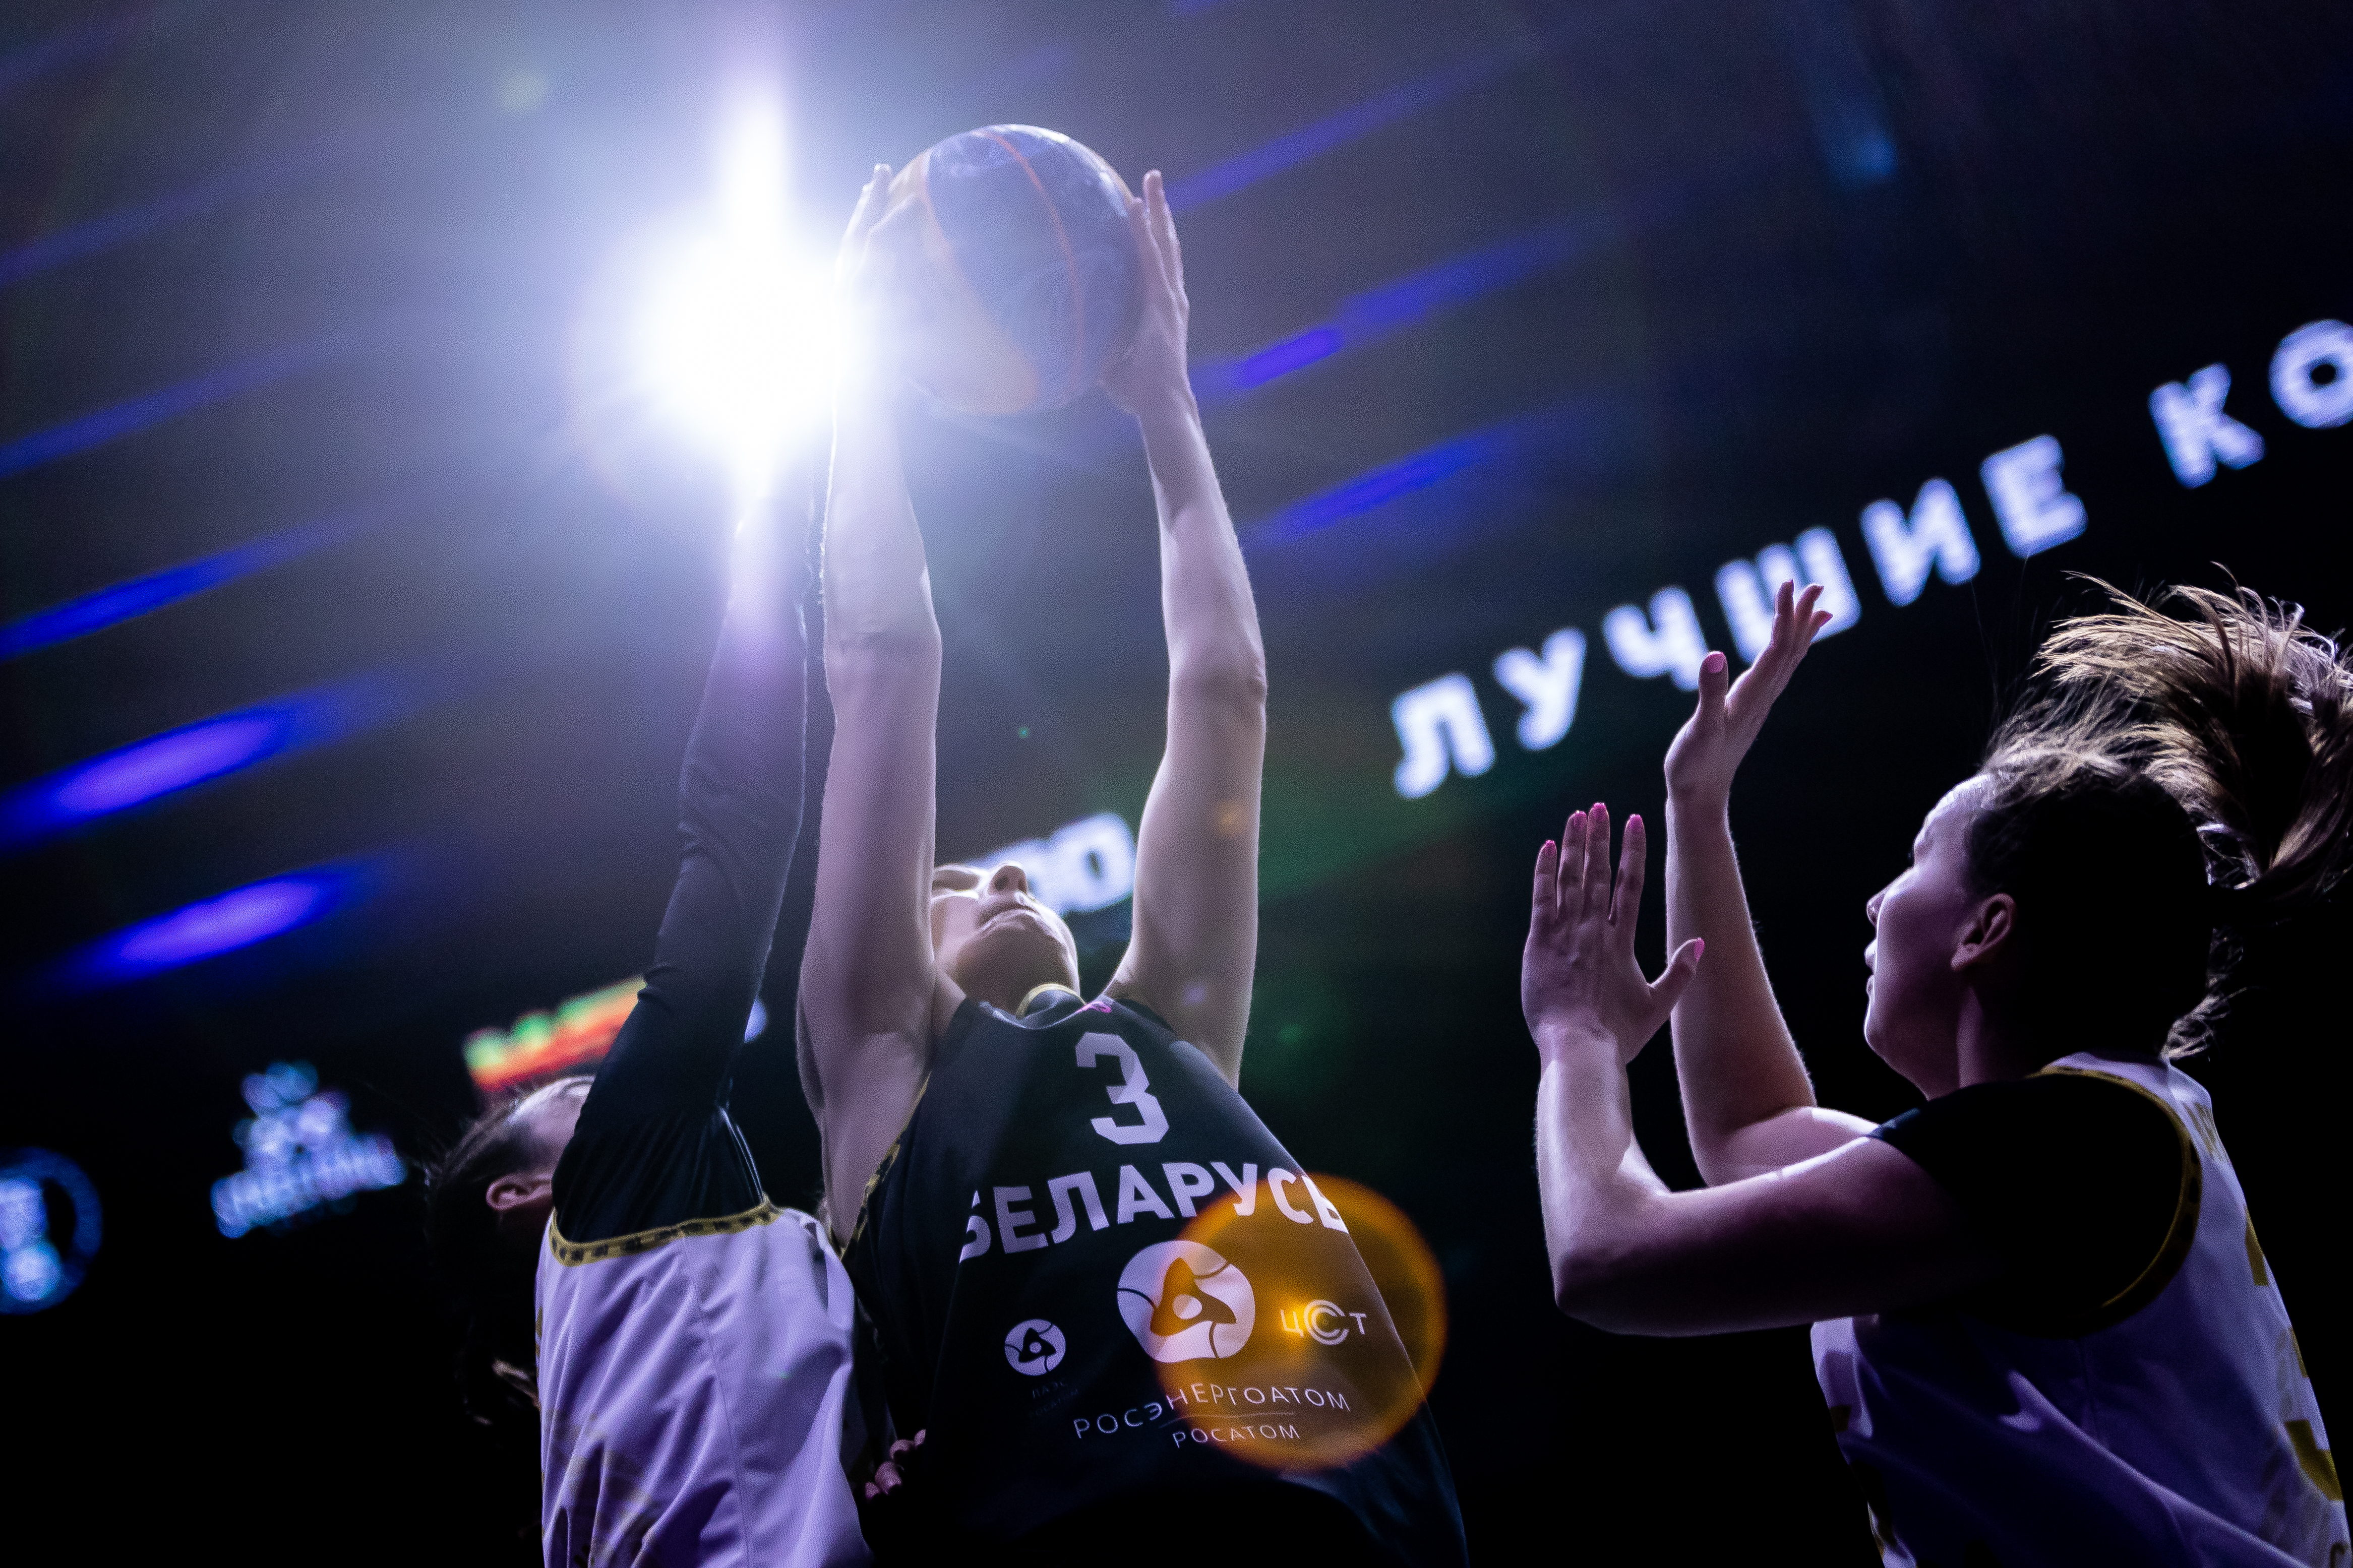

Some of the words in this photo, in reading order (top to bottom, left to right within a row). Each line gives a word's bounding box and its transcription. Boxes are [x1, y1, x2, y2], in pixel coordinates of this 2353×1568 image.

[1391, 432, 2088, 800] ЛУЧШИЕ
[1075, 1031, 1170, 1145] 3
[1072, 1382, 1351, 1439] РОСЭНЕРГОАТОМ
[1172, 1424, 1301, 1449] РОСАТОМ
